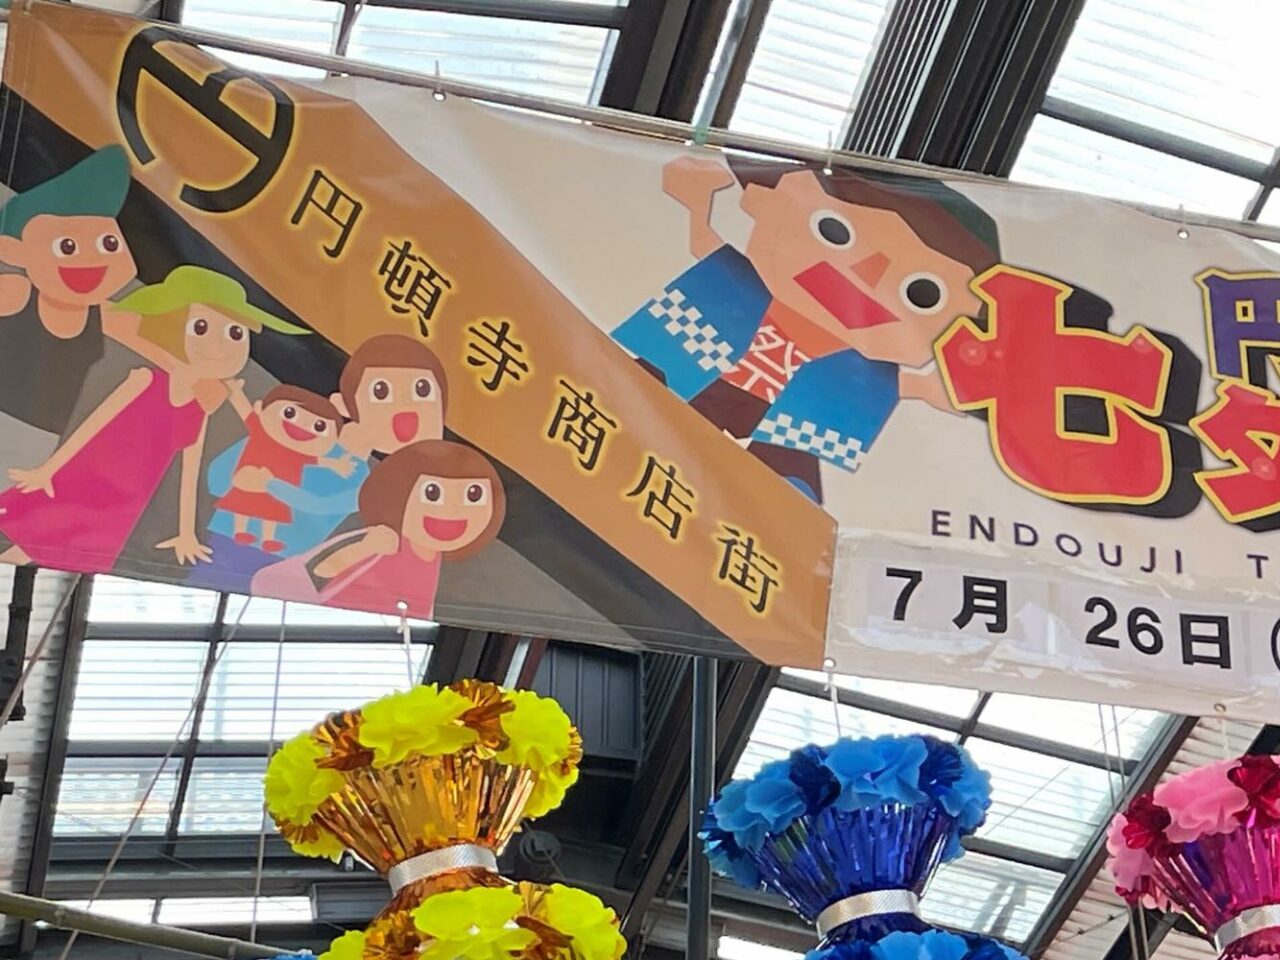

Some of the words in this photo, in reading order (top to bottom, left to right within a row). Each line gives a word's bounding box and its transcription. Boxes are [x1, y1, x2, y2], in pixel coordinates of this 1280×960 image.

[290, 169, 780, 613] 円頓寺商店街
[930, 509, 1184, 575] ENDOUJI
